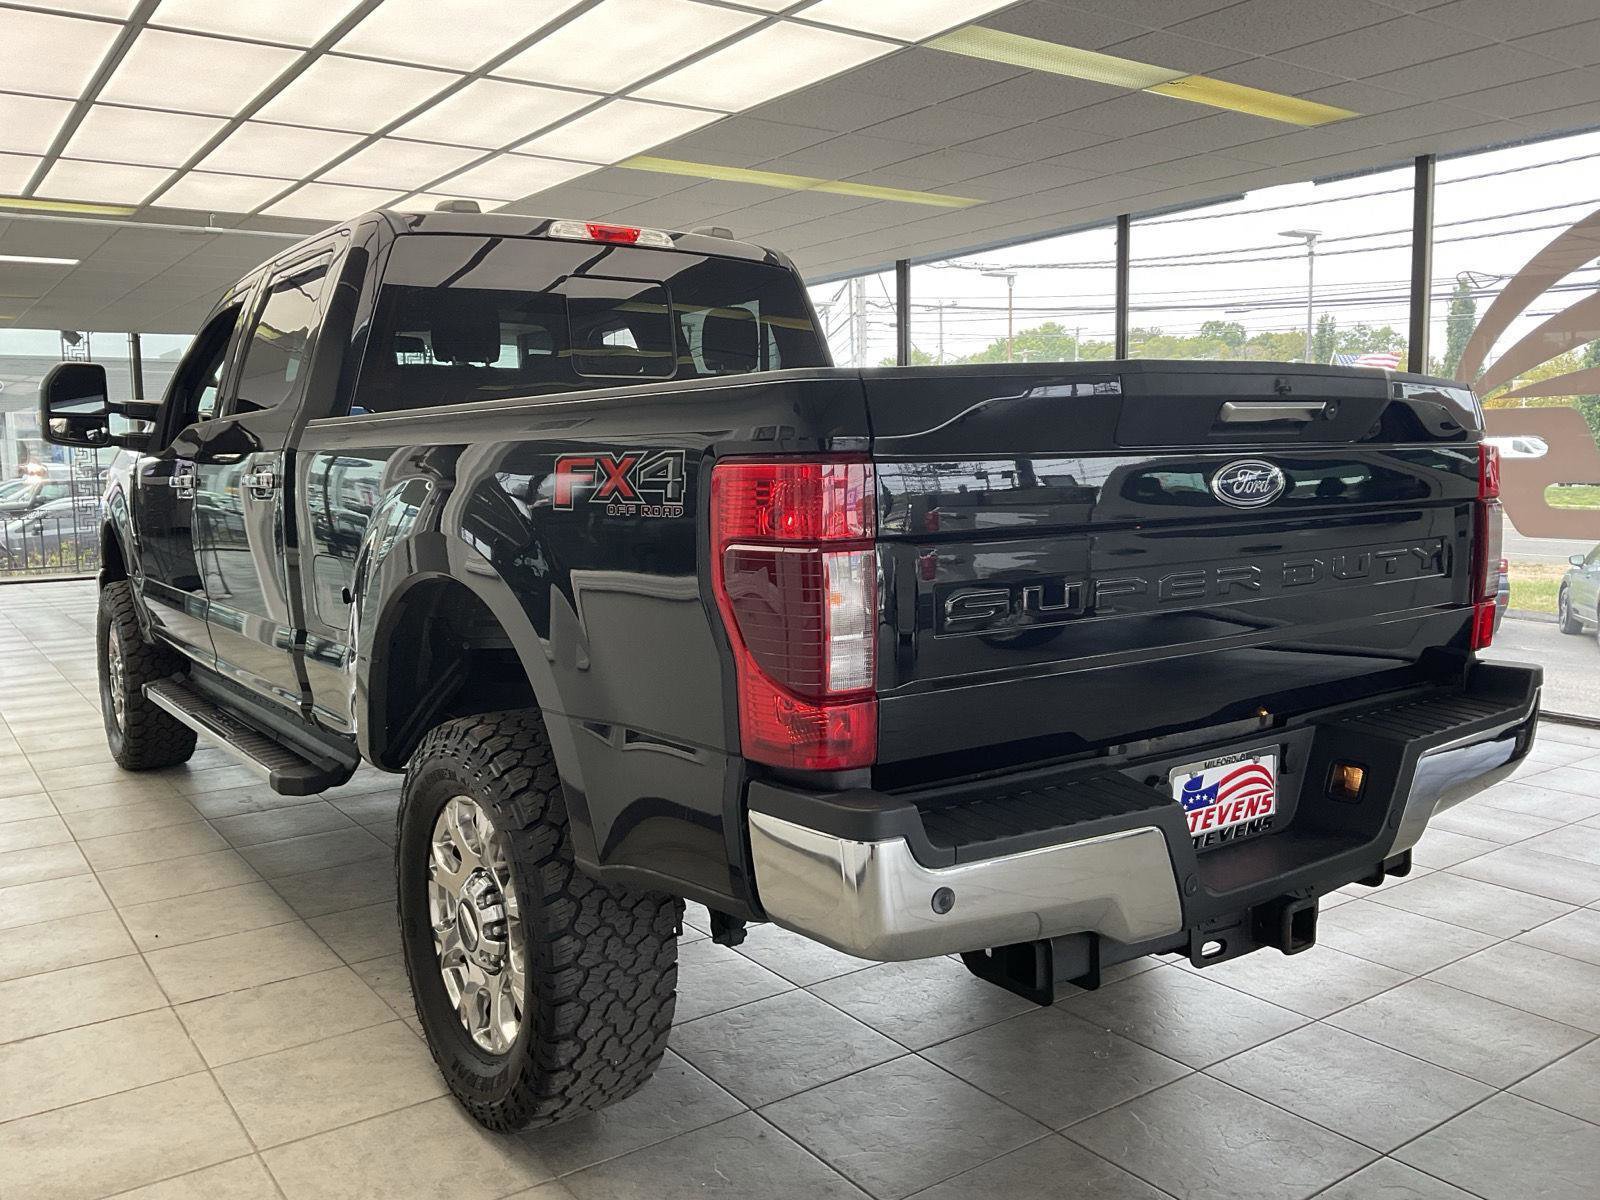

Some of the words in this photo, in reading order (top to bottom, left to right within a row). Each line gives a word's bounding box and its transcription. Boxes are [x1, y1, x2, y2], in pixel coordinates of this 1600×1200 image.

[553, 450, 686, 511] FX4
[1230, 468, 1273, 495] Ford
[607, 504, 636, 516] OFF
[641, 505, 684, 518] ROAD
[944, 565, 1262, 631] SUPER
[1281, 542, 1443, 589] DUTY
[1187, 792, 1274, 833] TEVENS
[1192, 817, 1273, 849] TEVENS
